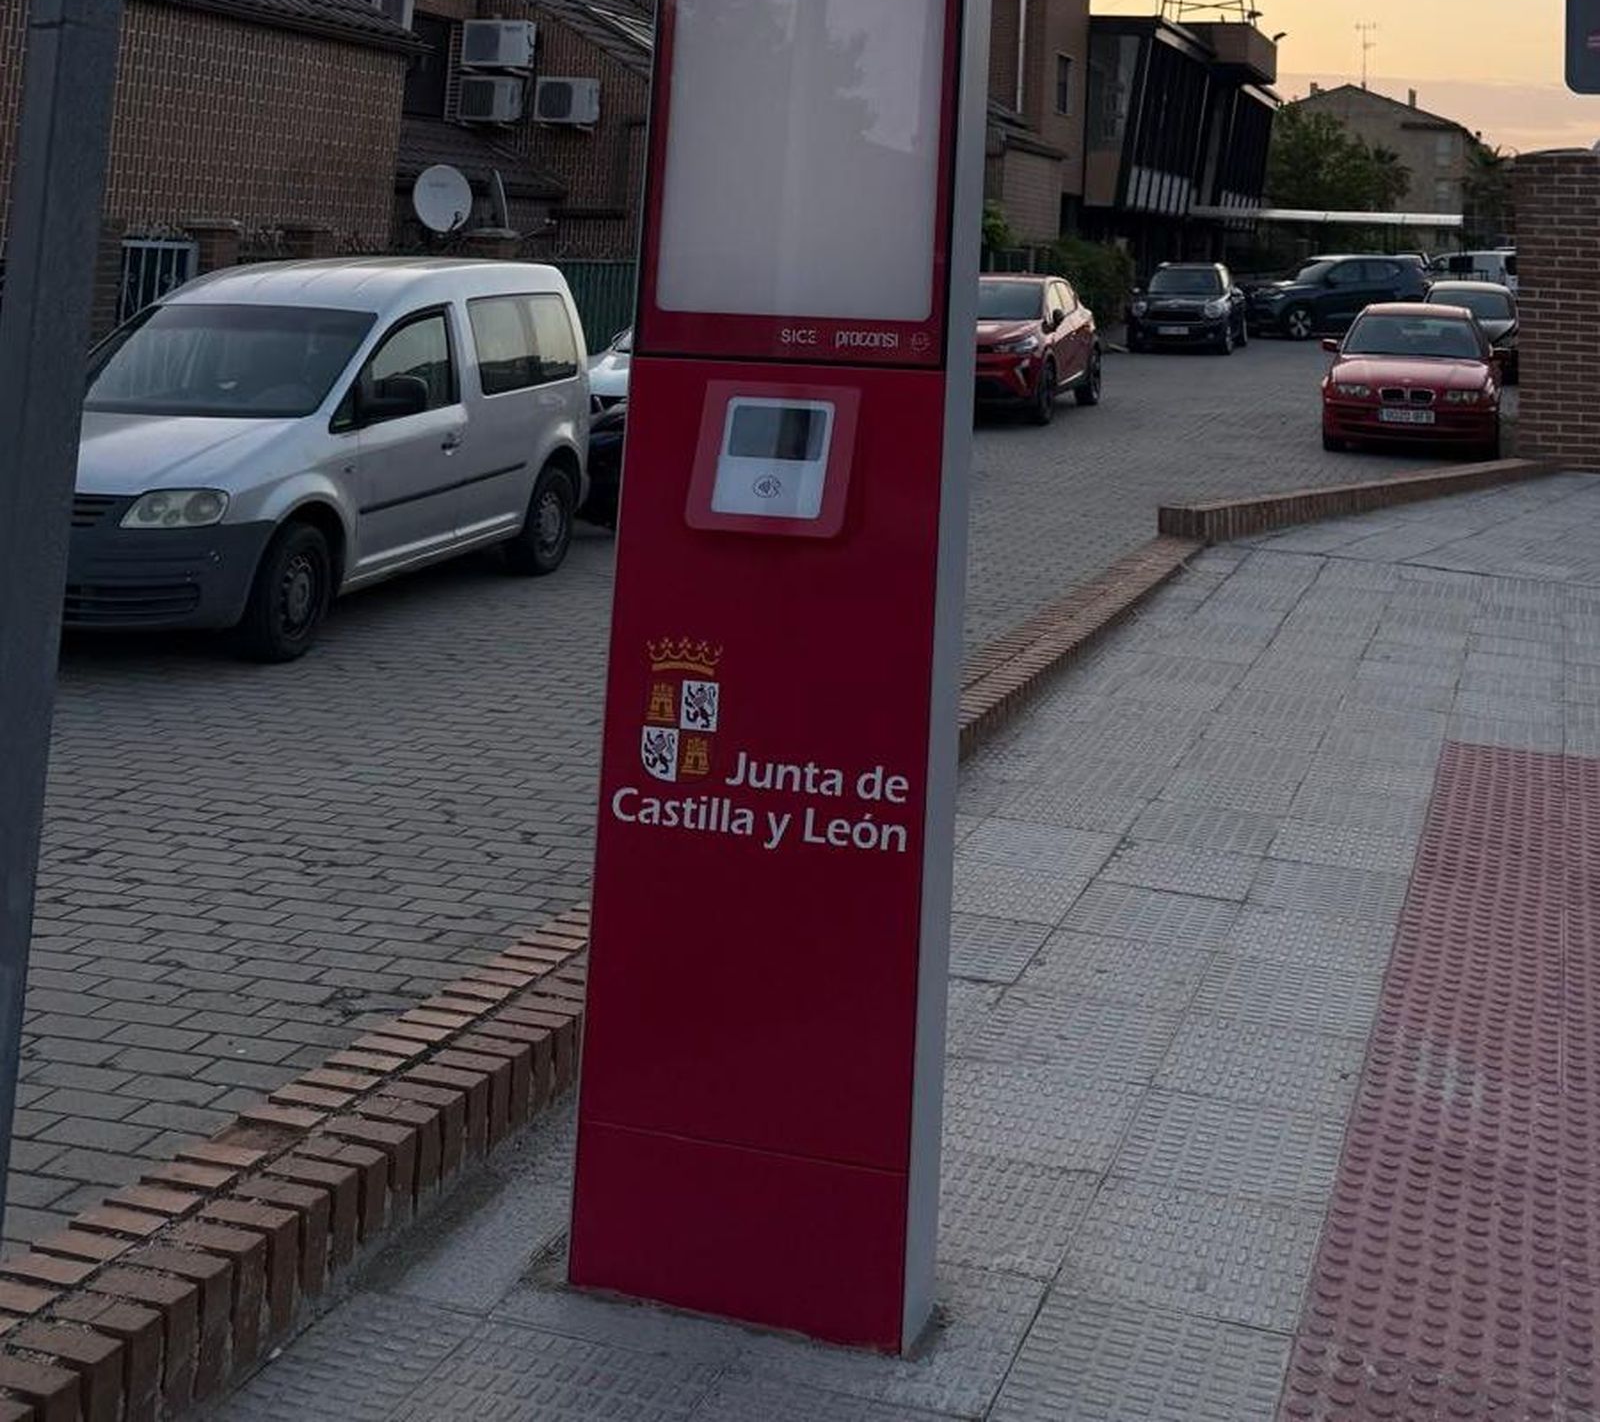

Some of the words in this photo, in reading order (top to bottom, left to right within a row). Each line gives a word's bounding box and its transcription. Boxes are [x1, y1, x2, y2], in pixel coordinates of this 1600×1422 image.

[781, 328, 817, 345] SICE
[835, 330, 899, 348] proconsi
[726, 751, 843, 797] Junta
[856, 765, 909, 803] de
[611, 786, 753, 836] Castilla
[763, 811, 792, 850] y
[803, 807, 907, 852] León
